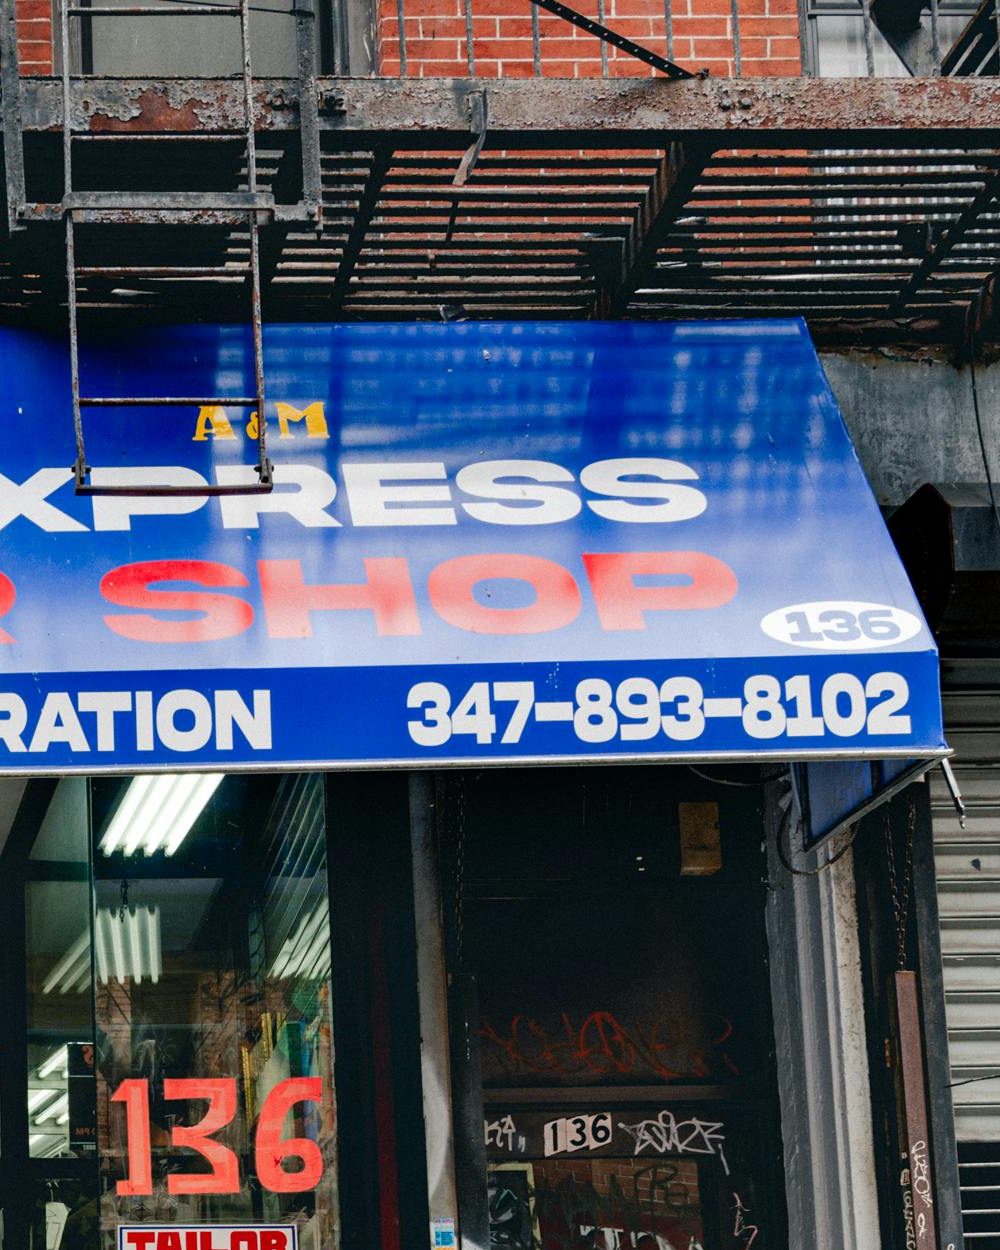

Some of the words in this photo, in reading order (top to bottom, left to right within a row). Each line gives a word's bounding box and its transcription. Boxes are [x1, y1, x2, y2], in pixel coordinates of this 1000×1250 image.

[100, 550, 739, 644] SHOP
[786, 609, 901, 643] 136
[407, 671, 913, 746] 347-893-8102
[110, 1077, 325, 1196] 136
[550, 1113, 611, 1151] 136
